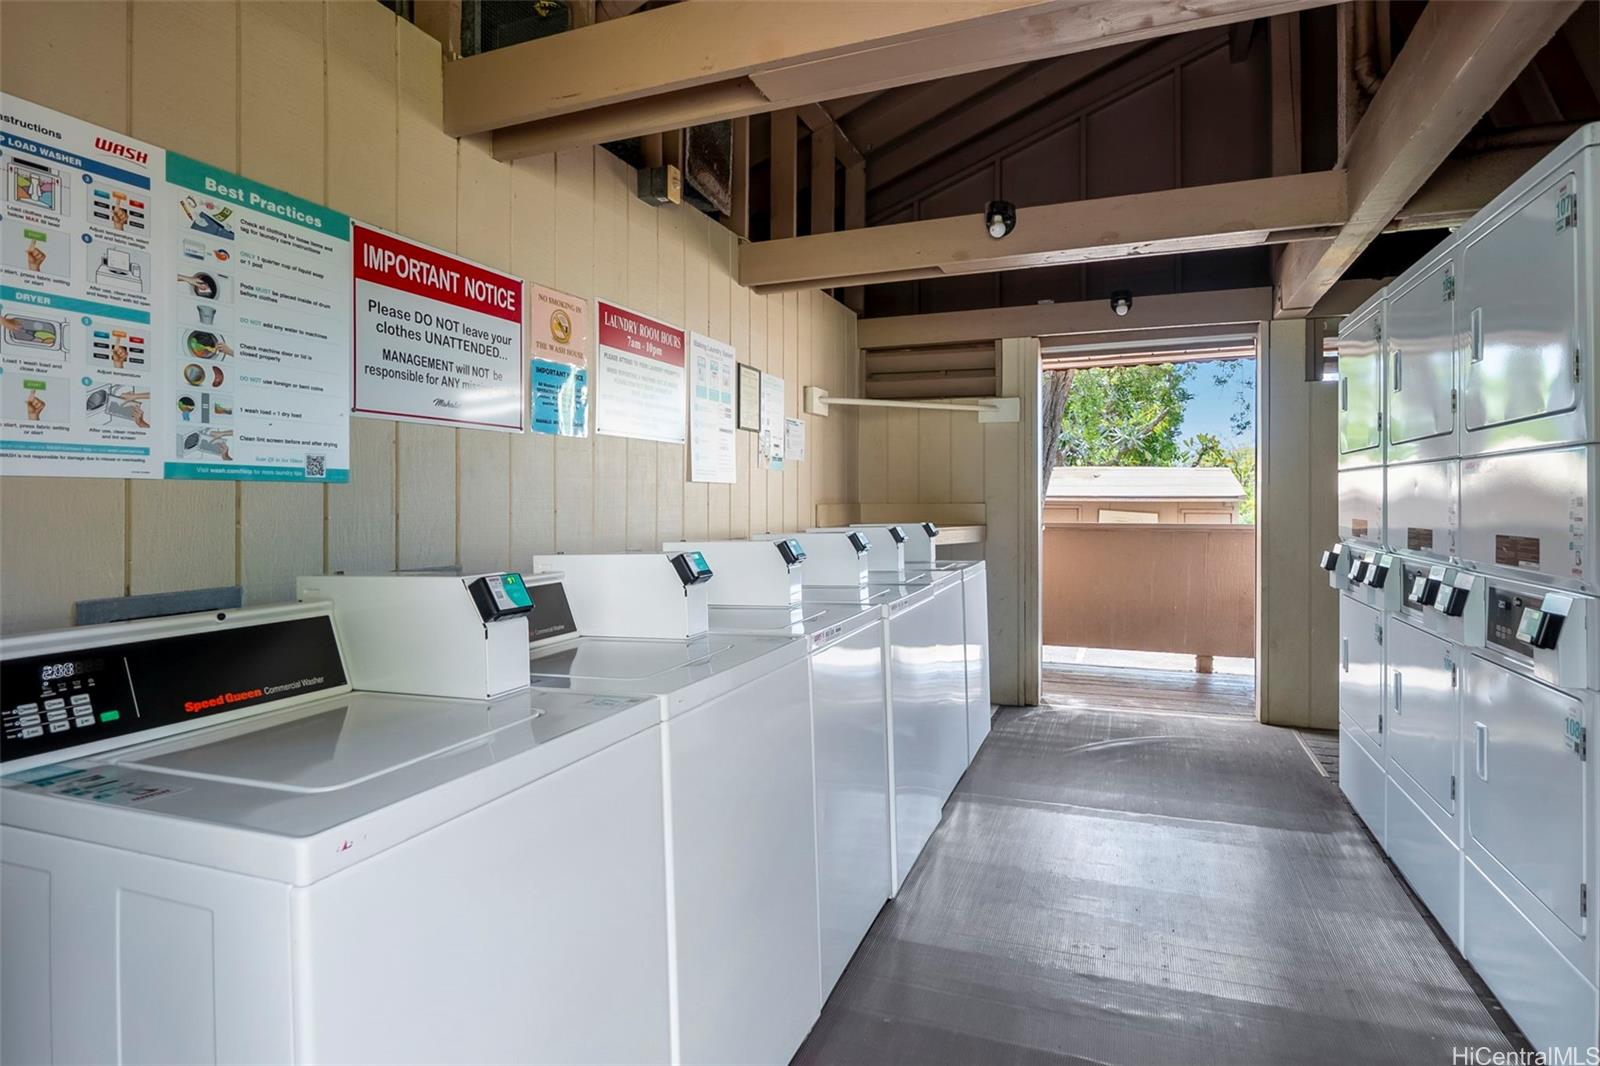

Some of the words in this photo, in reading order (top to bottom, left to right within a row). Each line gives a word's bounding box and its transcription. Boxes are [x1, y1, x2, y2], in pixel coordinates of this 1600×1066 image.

[8, 138, 37, 152] LOAD
[40, 147, 82, 166] WASHER
[95, 137, 148, 164] WASH
[205, 176, 244, 202] Best
[249, 192, 322, 228] Practices
[240, 218, 258, 229] Check
[266, 226, 287, 239] clothing
[296, 235, 310, 244] loose
[240, 226, 249, 234] tag
[250, 228, 259, 236] for
[259, 231, 279, 243] laundry
[292, 242, 321, 255] instructions
[363, 243, 460, 294] IMPORTANT
[464, 276, 516, 311] NOTICE
[15, 292, 51, 305] DRYER
[538, 293, 548, 303] NO
[549, 296, 575, 311] SMOKING
[575, 305, 582, 313] IN
[368, 299, 411, 321] Please
[415, 311, 432, 326] DO
[436, 316, 460, 333] NOT
[463, 323, 489, 340] leave
[490, 332, 512, 346] your
[604, 311, 638, 335] LAUNDRY
[639, 323, 660, 342] ROOM
[661, 329, 681, 349] HOURS
[240, 343, 257, 351] Check
[258, 347, 280, 355] machine
[376, 321, 421, 341] clothes
[425, 330, 508, 361] UNATTENDED...
[536, 341, 547, 350] THE
[549, 344, 566, 355] WASH
[567, 348, 583, 359] HOUSE
[627, 336, 641, 350] 7am
[646, 341, 662, 357] 10pm
[259, 354, 280, 362] properly
[382, 348, 454, 373] MANAGEMENT
[456, 363, 470, 376] will
[472, 364, 489, 378] NOT
[493, 369, 503, 382] be
[535, 366, 566, 377] IMPORTANT
[364, 364, 424, 384] responsible
[425, 373, 439, 385] for
[441, 375, 460, 389] ANY
[185, 694, 224, 713] Speed
[225, 688, 262, 704] Queen
[263, 681, 302, 696] Commercial
[302, 675, 325, 688] Washer
